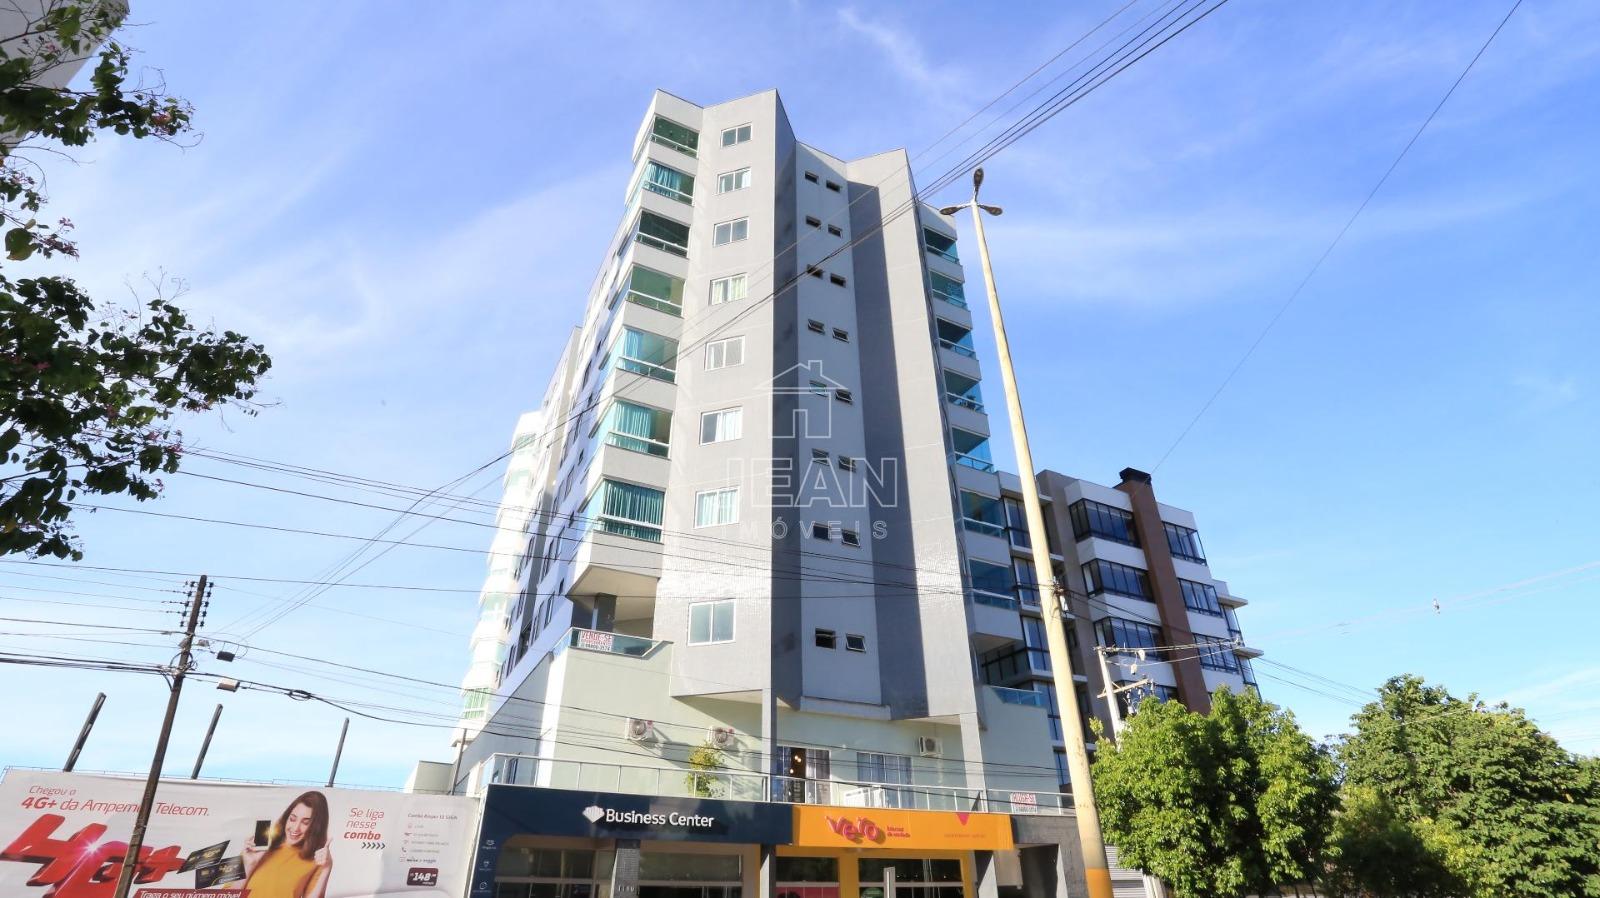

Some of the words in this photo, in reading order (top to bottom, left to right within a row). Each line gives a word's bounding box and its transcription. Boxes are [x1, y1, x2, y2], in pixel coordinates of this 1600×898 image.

[29, 785, 67, 796] Chegou
[21, 797, 57, 809] 4G+
[60, 799, 79, 811] da
[156, 802, 209, 816] Telecom.
[349, 807, 363, 818] Se
[365, 808, 385, 820] liga
[605, 808, 666, 825] Business
[669, 812, 715, 828] Center
[346, 819, 377, 830] nesse
[343, 831, 382, 841] combo
[412, 872, 432, 881] 148
